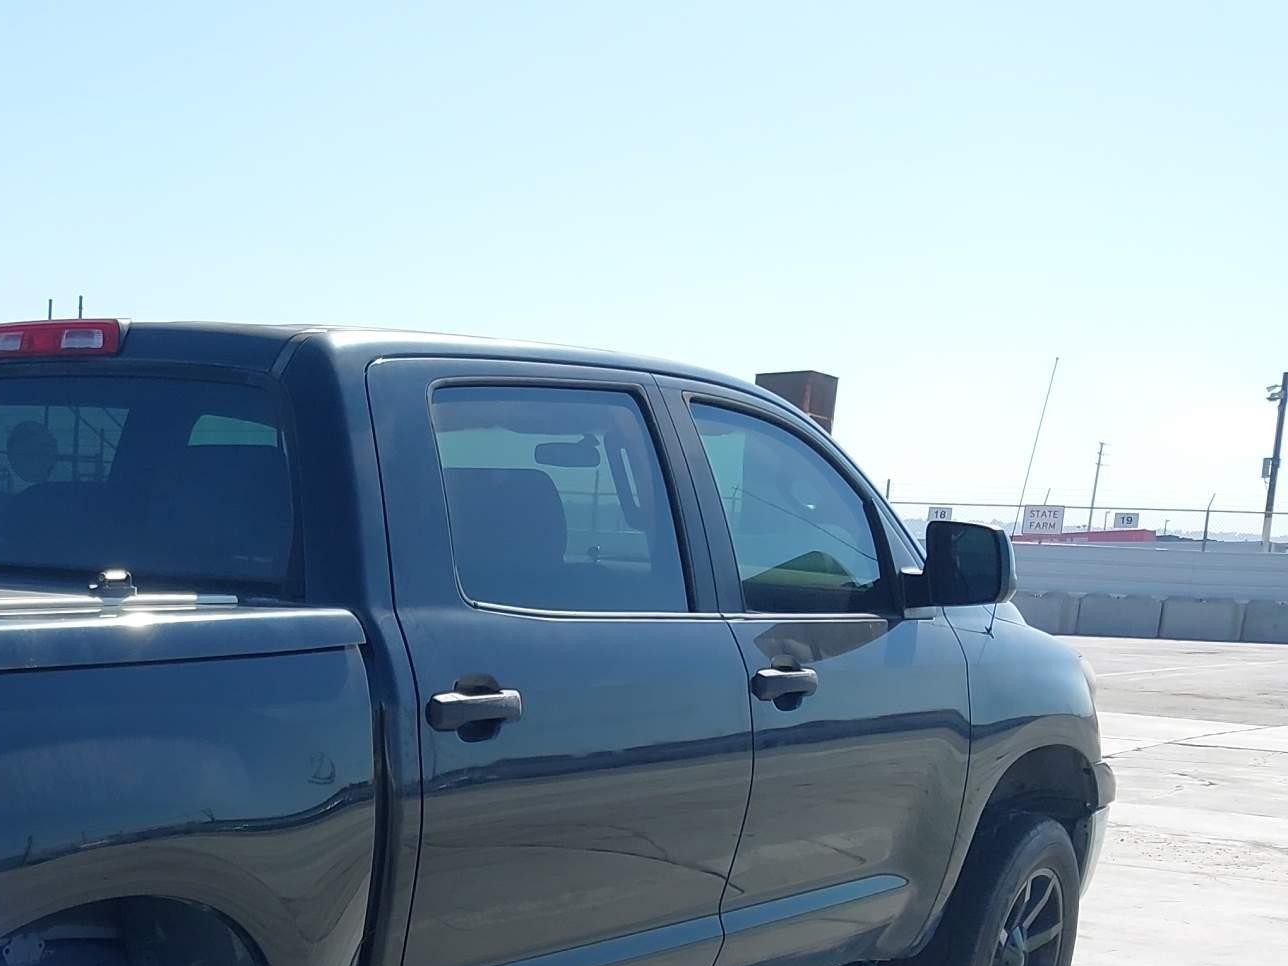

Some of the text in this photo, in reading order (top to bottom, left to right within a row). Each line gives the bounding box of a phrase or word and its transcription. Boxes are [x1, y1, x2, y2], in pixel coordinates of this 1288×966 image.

[934, 510, 946, 519] 18
[1030, 509, 1059, 519] STATE
[1121, 516, 1133, 525] 19
[1029, 521, 1056, 530] FARM
